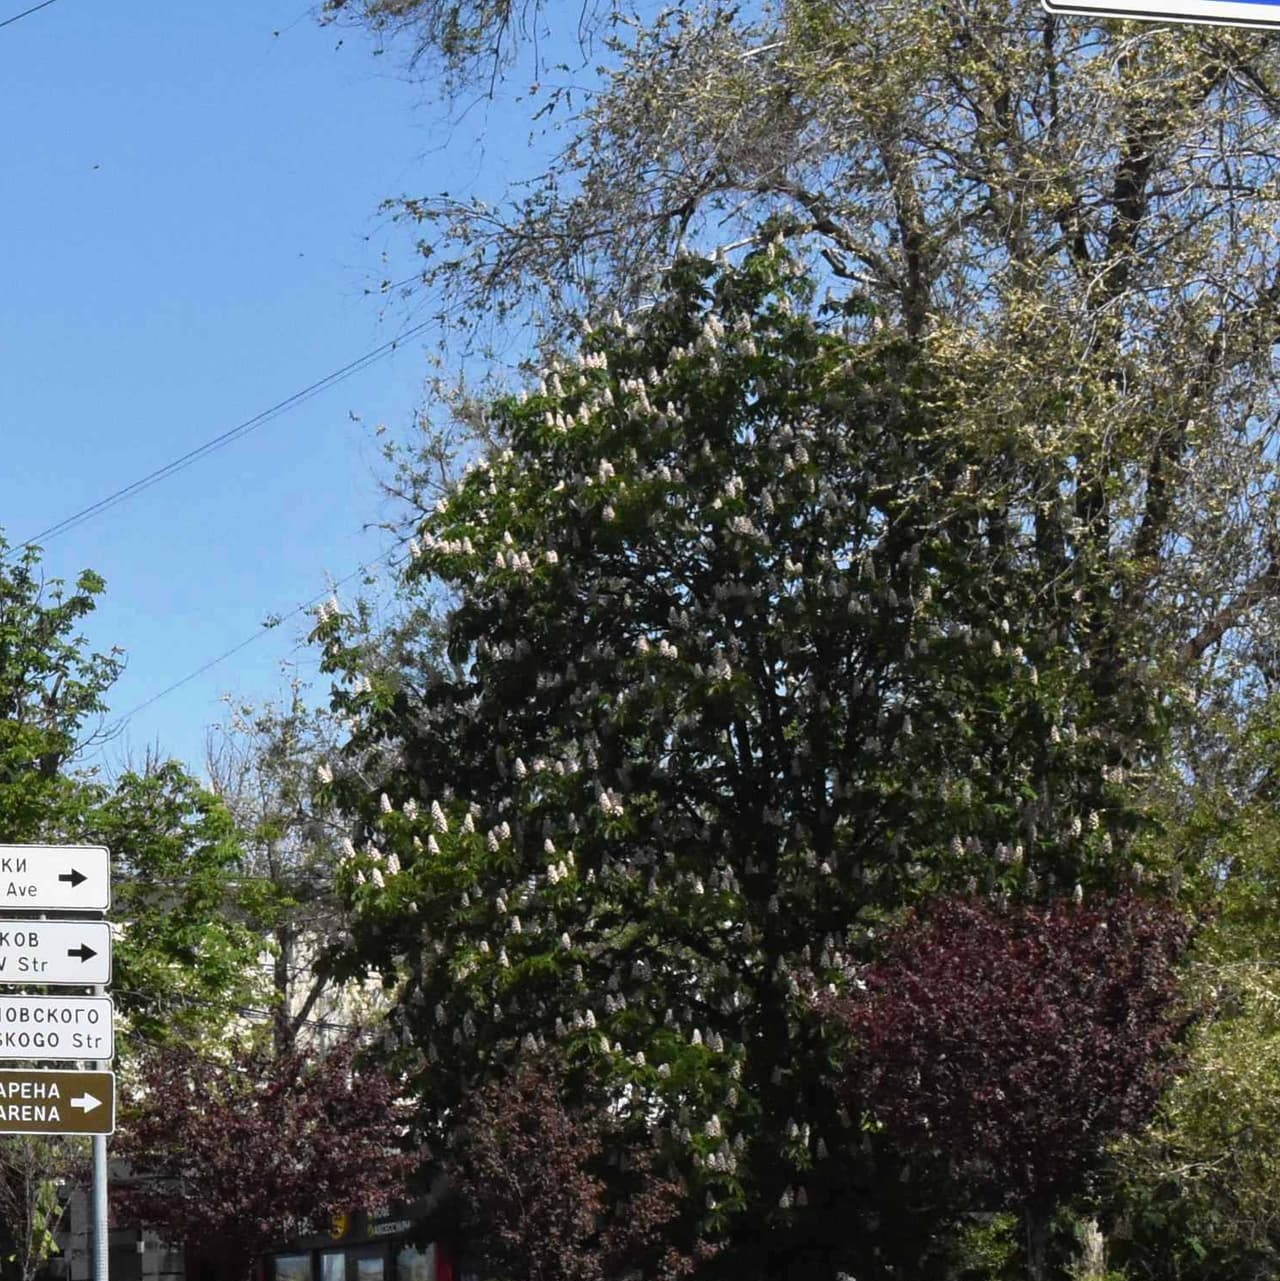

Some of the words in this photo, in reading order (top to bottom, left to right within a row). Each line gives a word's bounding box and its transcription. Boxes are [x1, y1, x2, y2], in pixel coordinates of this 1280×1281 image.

[6, 883, 38, 898] Ave
[17, 957, 49, 972] Str
[72, 1034, 103, 1049] Str
